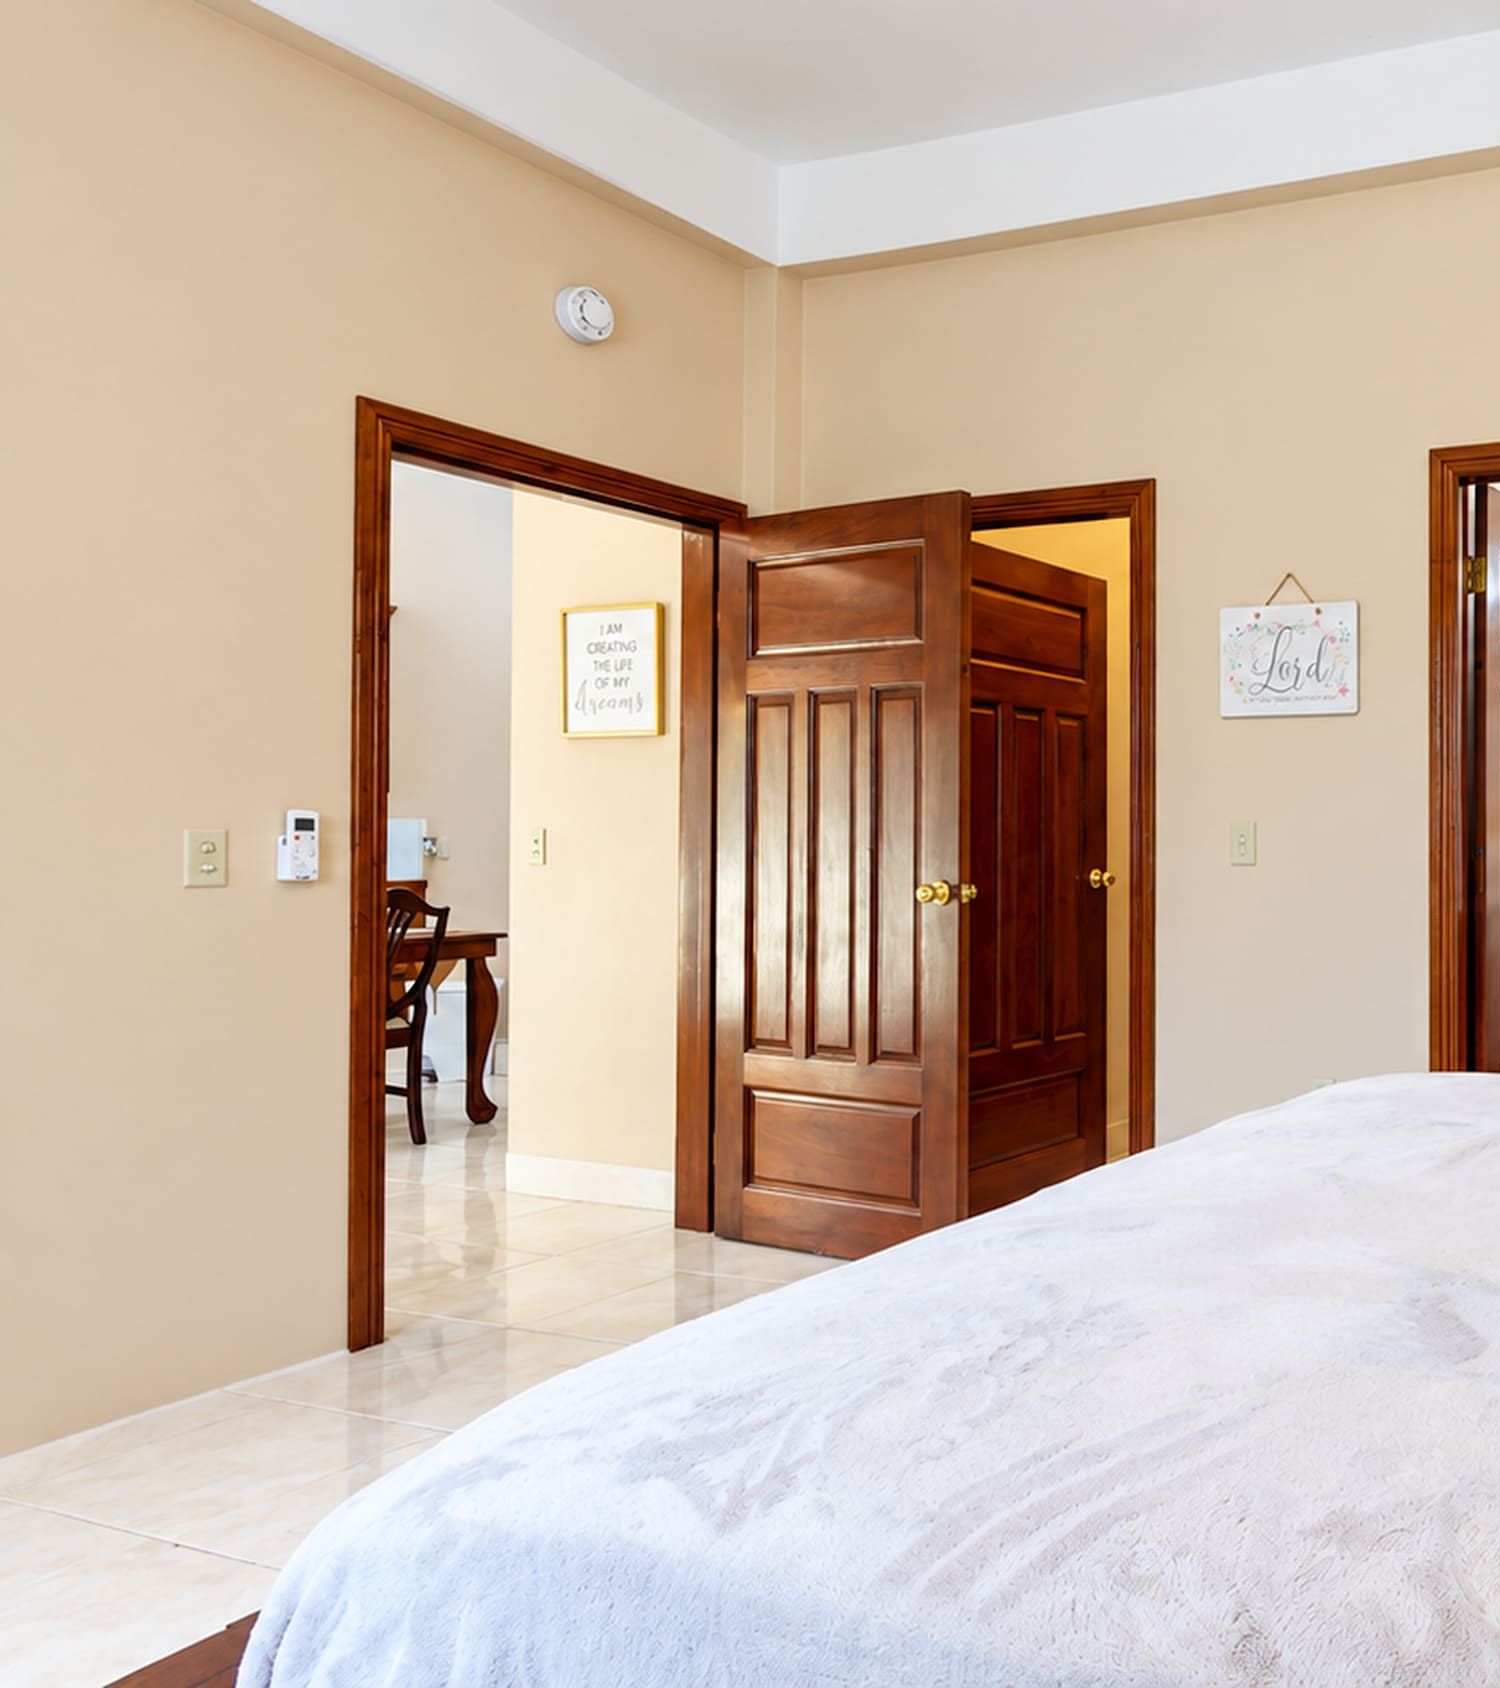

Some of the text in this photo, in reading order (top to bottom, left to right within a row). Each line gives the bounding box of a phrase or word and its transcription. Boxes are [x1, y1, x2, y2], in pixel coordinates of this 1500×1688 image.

[606, 623, 623, 635] AM
[586, 640, 638, 655] CREATING
[593, 658, 633, 673] THE LIFE
[1248, 625, 1330, 696] Lord
[594, 677, 630, 690] OF MY
[575, 679, 644, 716] dreams
